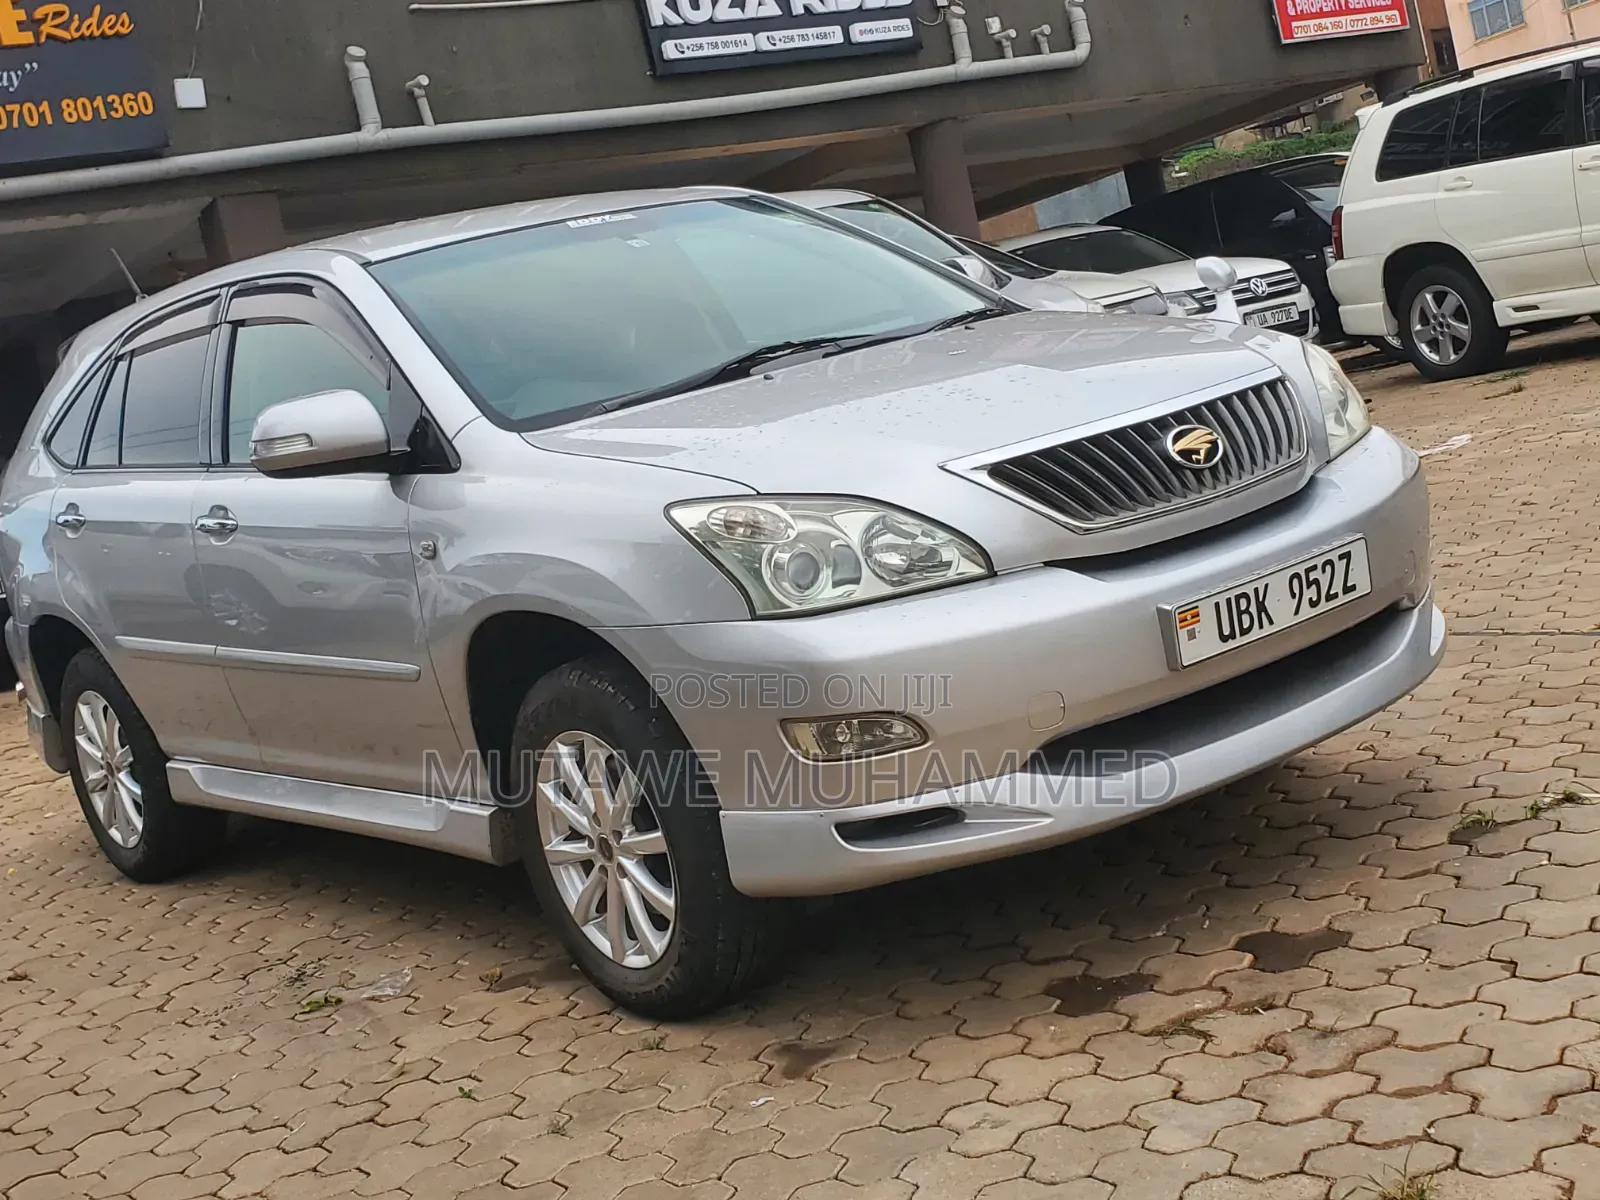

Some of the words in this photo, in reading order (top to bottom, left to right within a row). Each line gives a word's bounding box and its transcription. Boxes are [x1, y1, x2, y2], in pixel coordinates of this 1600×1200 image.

[32, 3, 135, 43] Rides
[875, 26, 892, 35] KUZA
[892, 24, 911, 33] RIDES
[1293, 24, 1311, 35] 0701
[1313, 22, 1329, 32] 084
[1331, 20, 1343, 30] 160
[1349, 17, 1369, 28] 0772
[686, 41, 705, 52] +256
[706, 40, 720, 51] 758
[721, 38, 748, 49] 001614
[778, 33, 796, 44] +256
[796, 32, 810, 42] 783
[811, 31, 837, 41] 145817
[61, 91, 154, 124] 801360
[1214, 582, 1275, 643] UBK
[1288, 550, 1357, 617] 952Z
